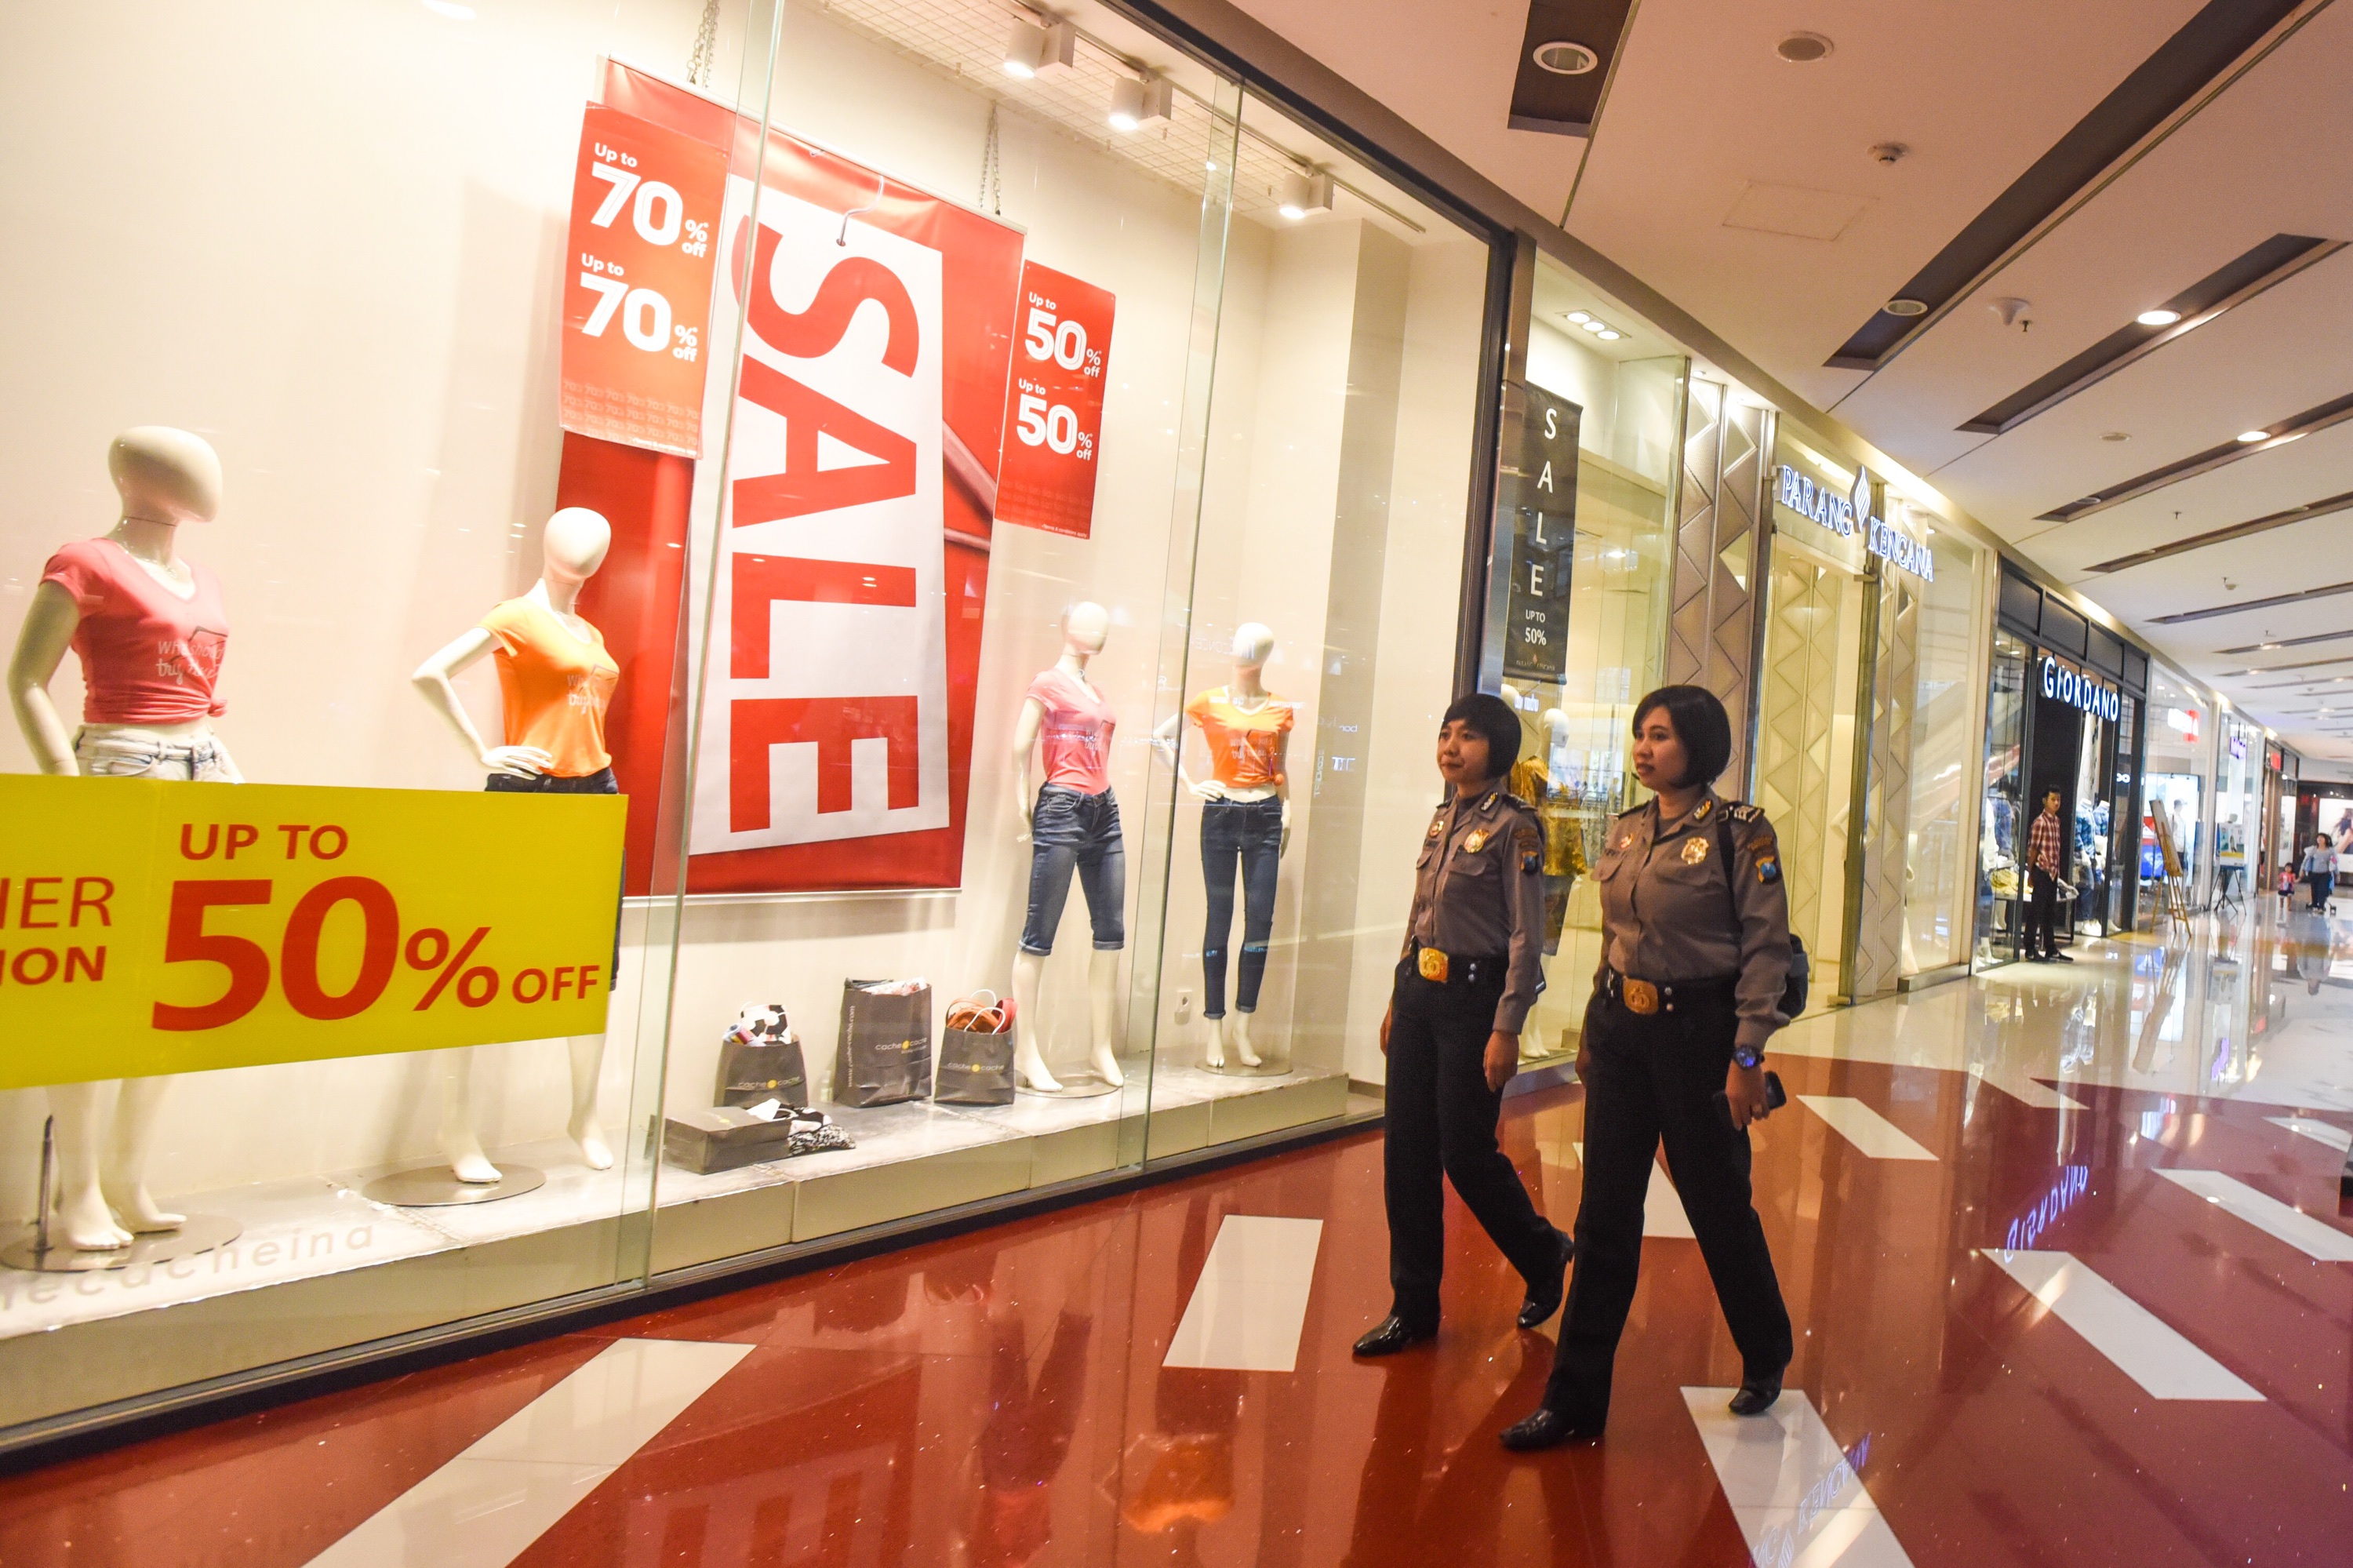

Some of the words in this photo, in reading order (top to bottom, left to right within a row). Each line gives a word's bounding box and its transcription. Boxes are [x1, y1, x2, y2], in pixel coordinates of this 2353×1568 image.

[595, 142, 617, 162] Up
[620, 153, 638, 167] to
[682, 241, 707, 258] off
[581, 253, 604, 272] Up
[607, 262, 624, 276] to
[1029, 291, 1044, 307] Up
[1046, 298, 1056, 310] to
[673, 346, 697, 362] off
[1084, 366, 1100, 378] off
[1018, 378, 1033, 394] Up
[1035, 384, 1046, 395] to
[1076, 449, 1093, 461] off
[1530, 408, 1557, 597] SALE
[730, 214, 920, 834] SALE
[1781, 464, 1853, 539] PARANG
[1868, 515, 1933, 583] KENCANA
[1525, 627, 1547, 646] 50%
[2044, 656, 2118, 722] GIORDANO
[179, 823, 260, 861] UP
[278, 824, 348, 860] TO
[0, 875, 115, 930] ER
[511, 965, 601, 1005] OFF
